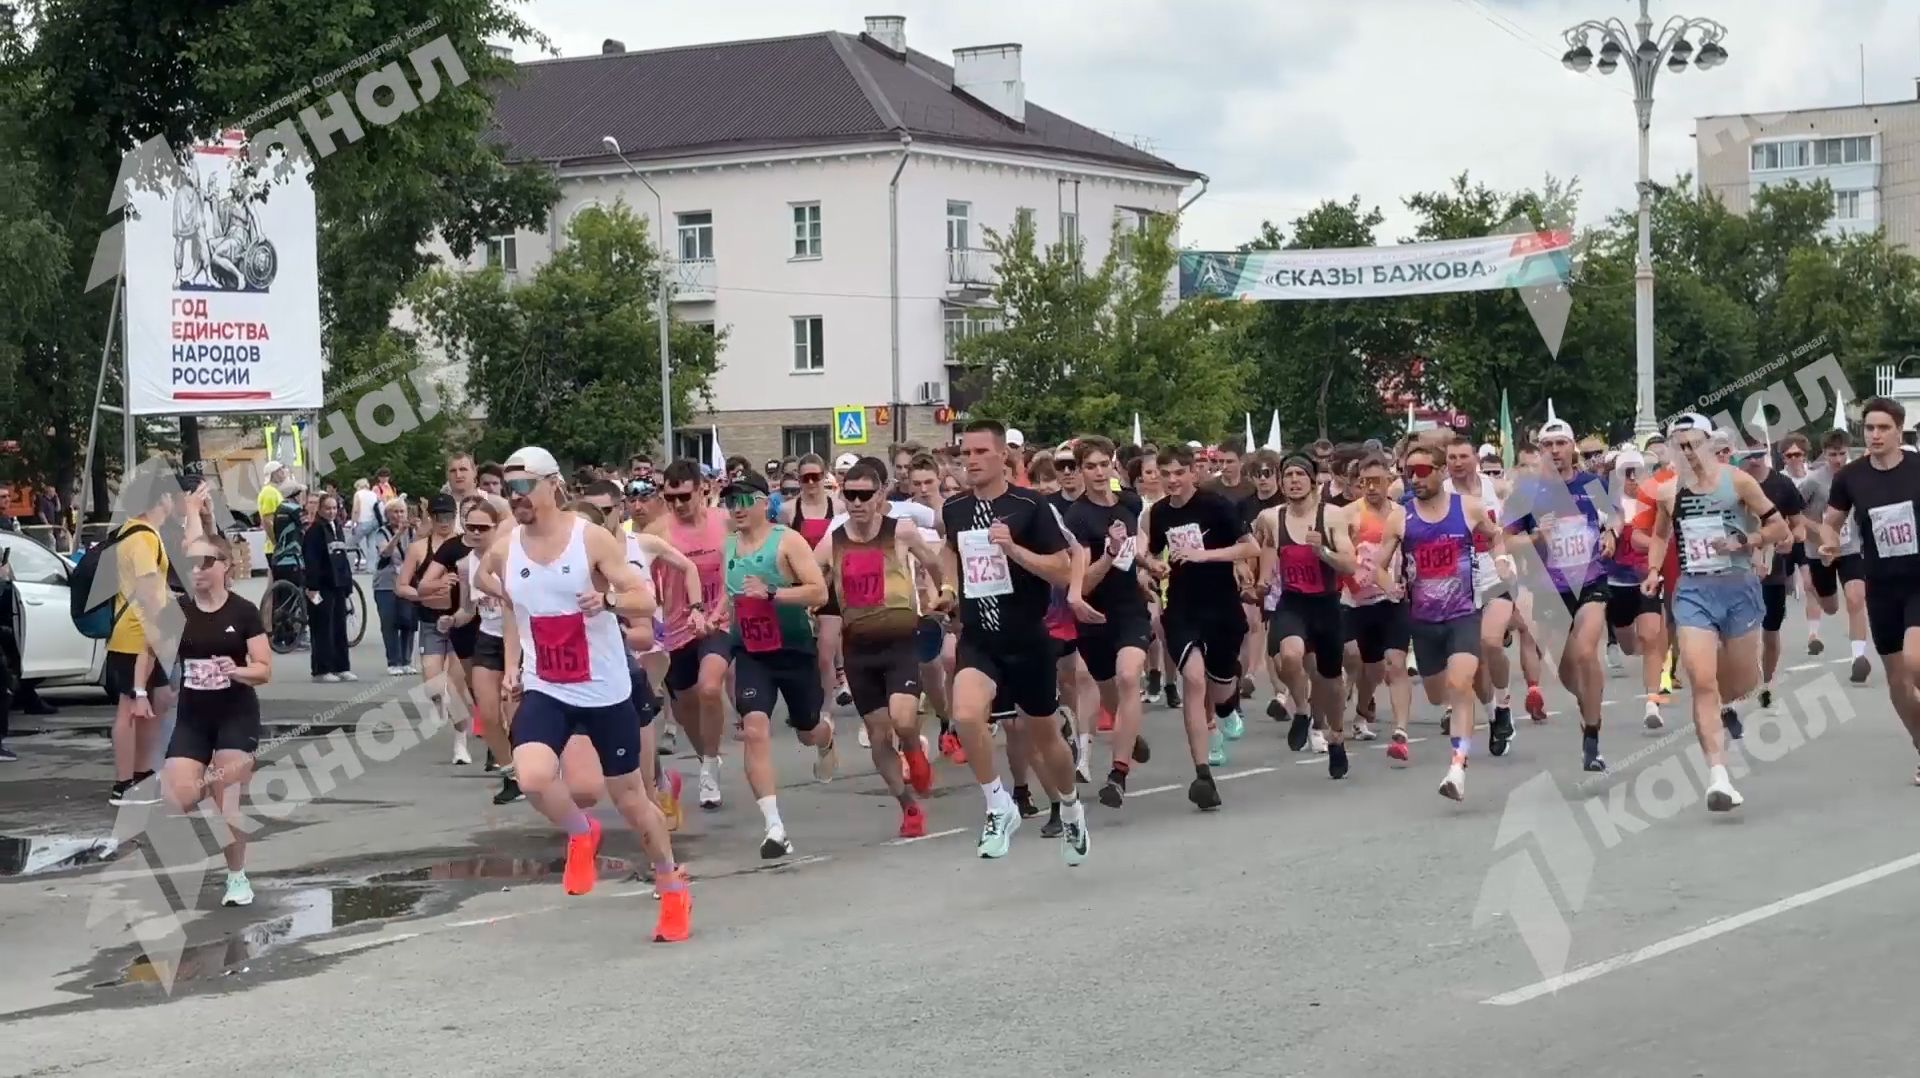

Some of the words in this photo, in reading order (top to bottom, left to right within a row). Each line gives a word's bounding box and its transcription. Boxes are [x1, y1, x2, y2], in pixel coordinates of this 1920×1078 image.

[1264, 267, 1364, 288] «СКАЗЫ
[1373, 259, 1499, 284] БАЖОВА»
[172, 298, 208, 319] ГОД
[172, 321, 269, 342] ЕДИНСТВА
[172, 344, 261, 365] НАРОДОВ
[172, 367, 250, 385] РОССИИ
[966, 555, 1007, 584] 525
